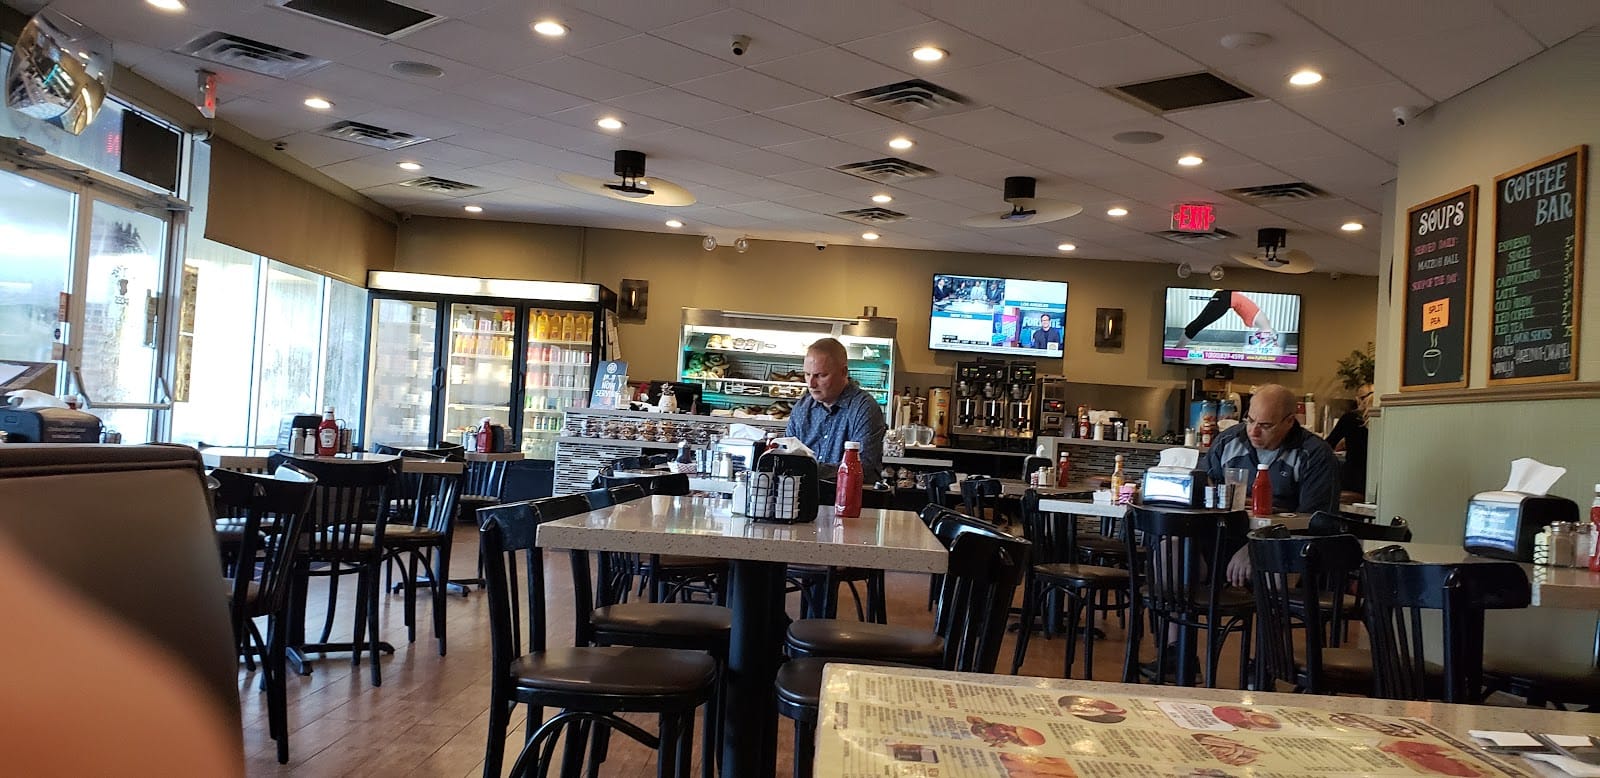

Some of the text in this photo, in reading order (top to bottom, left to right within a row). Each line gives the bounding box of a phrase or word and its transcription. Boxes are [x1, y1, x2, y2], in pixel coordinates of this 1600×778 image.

[1504, 162, 1568, 204] COFFEE
[1179, 205, 1212, 231] EXIT
[1418, 201, 1464, 235] SOUPS
[1535, 192, 1573, 227] BAR
[1495, 286, 1518, 301] LATTE
[1428, 303, 1443, 314] SPLIT
[1430, 316, 1441, 325] PEA
